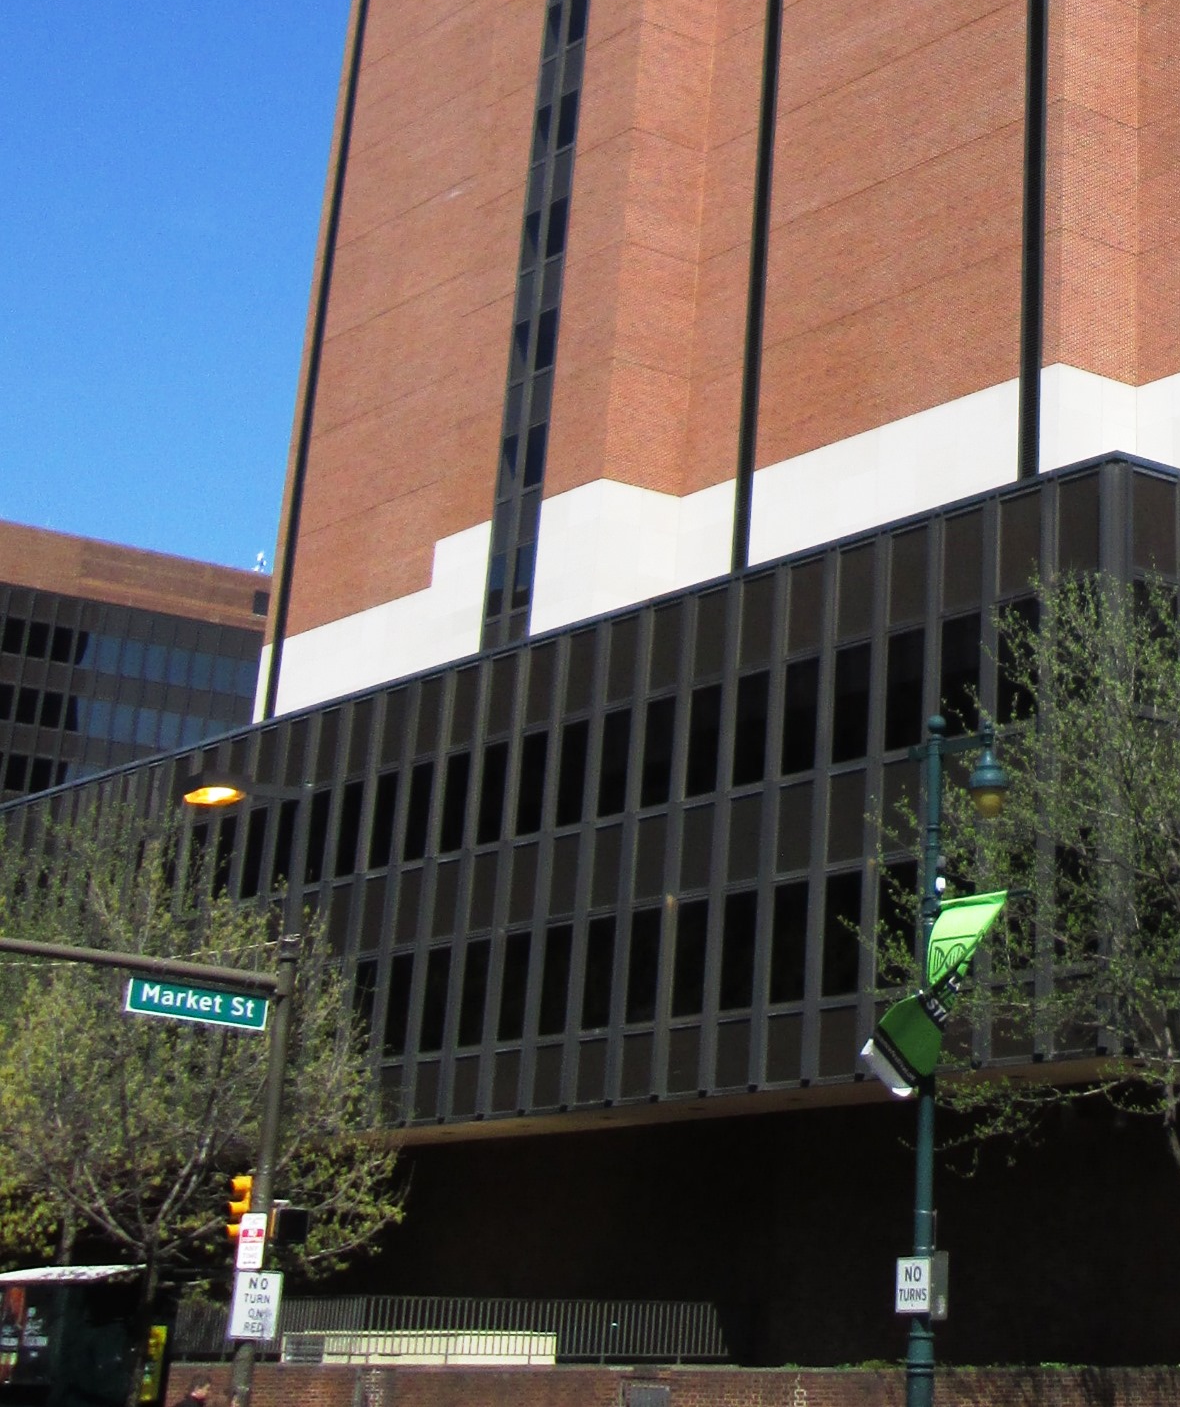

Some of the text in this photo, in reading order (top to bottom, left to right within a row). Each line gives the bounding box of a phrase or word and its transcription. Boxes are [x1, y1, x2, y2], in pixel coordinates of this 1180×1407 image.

[141, 983, 255, 1018] Market St
[904, 1266, 922, 1282] NO
[249, 1277, 269, 1290] NO
[244, 1293, 270, 1304] TURN
[899, 1288, 927, 1301] TURNS
[248, 1308, 263, 1319] ON
[244, 1322, 263, 1333] RED
